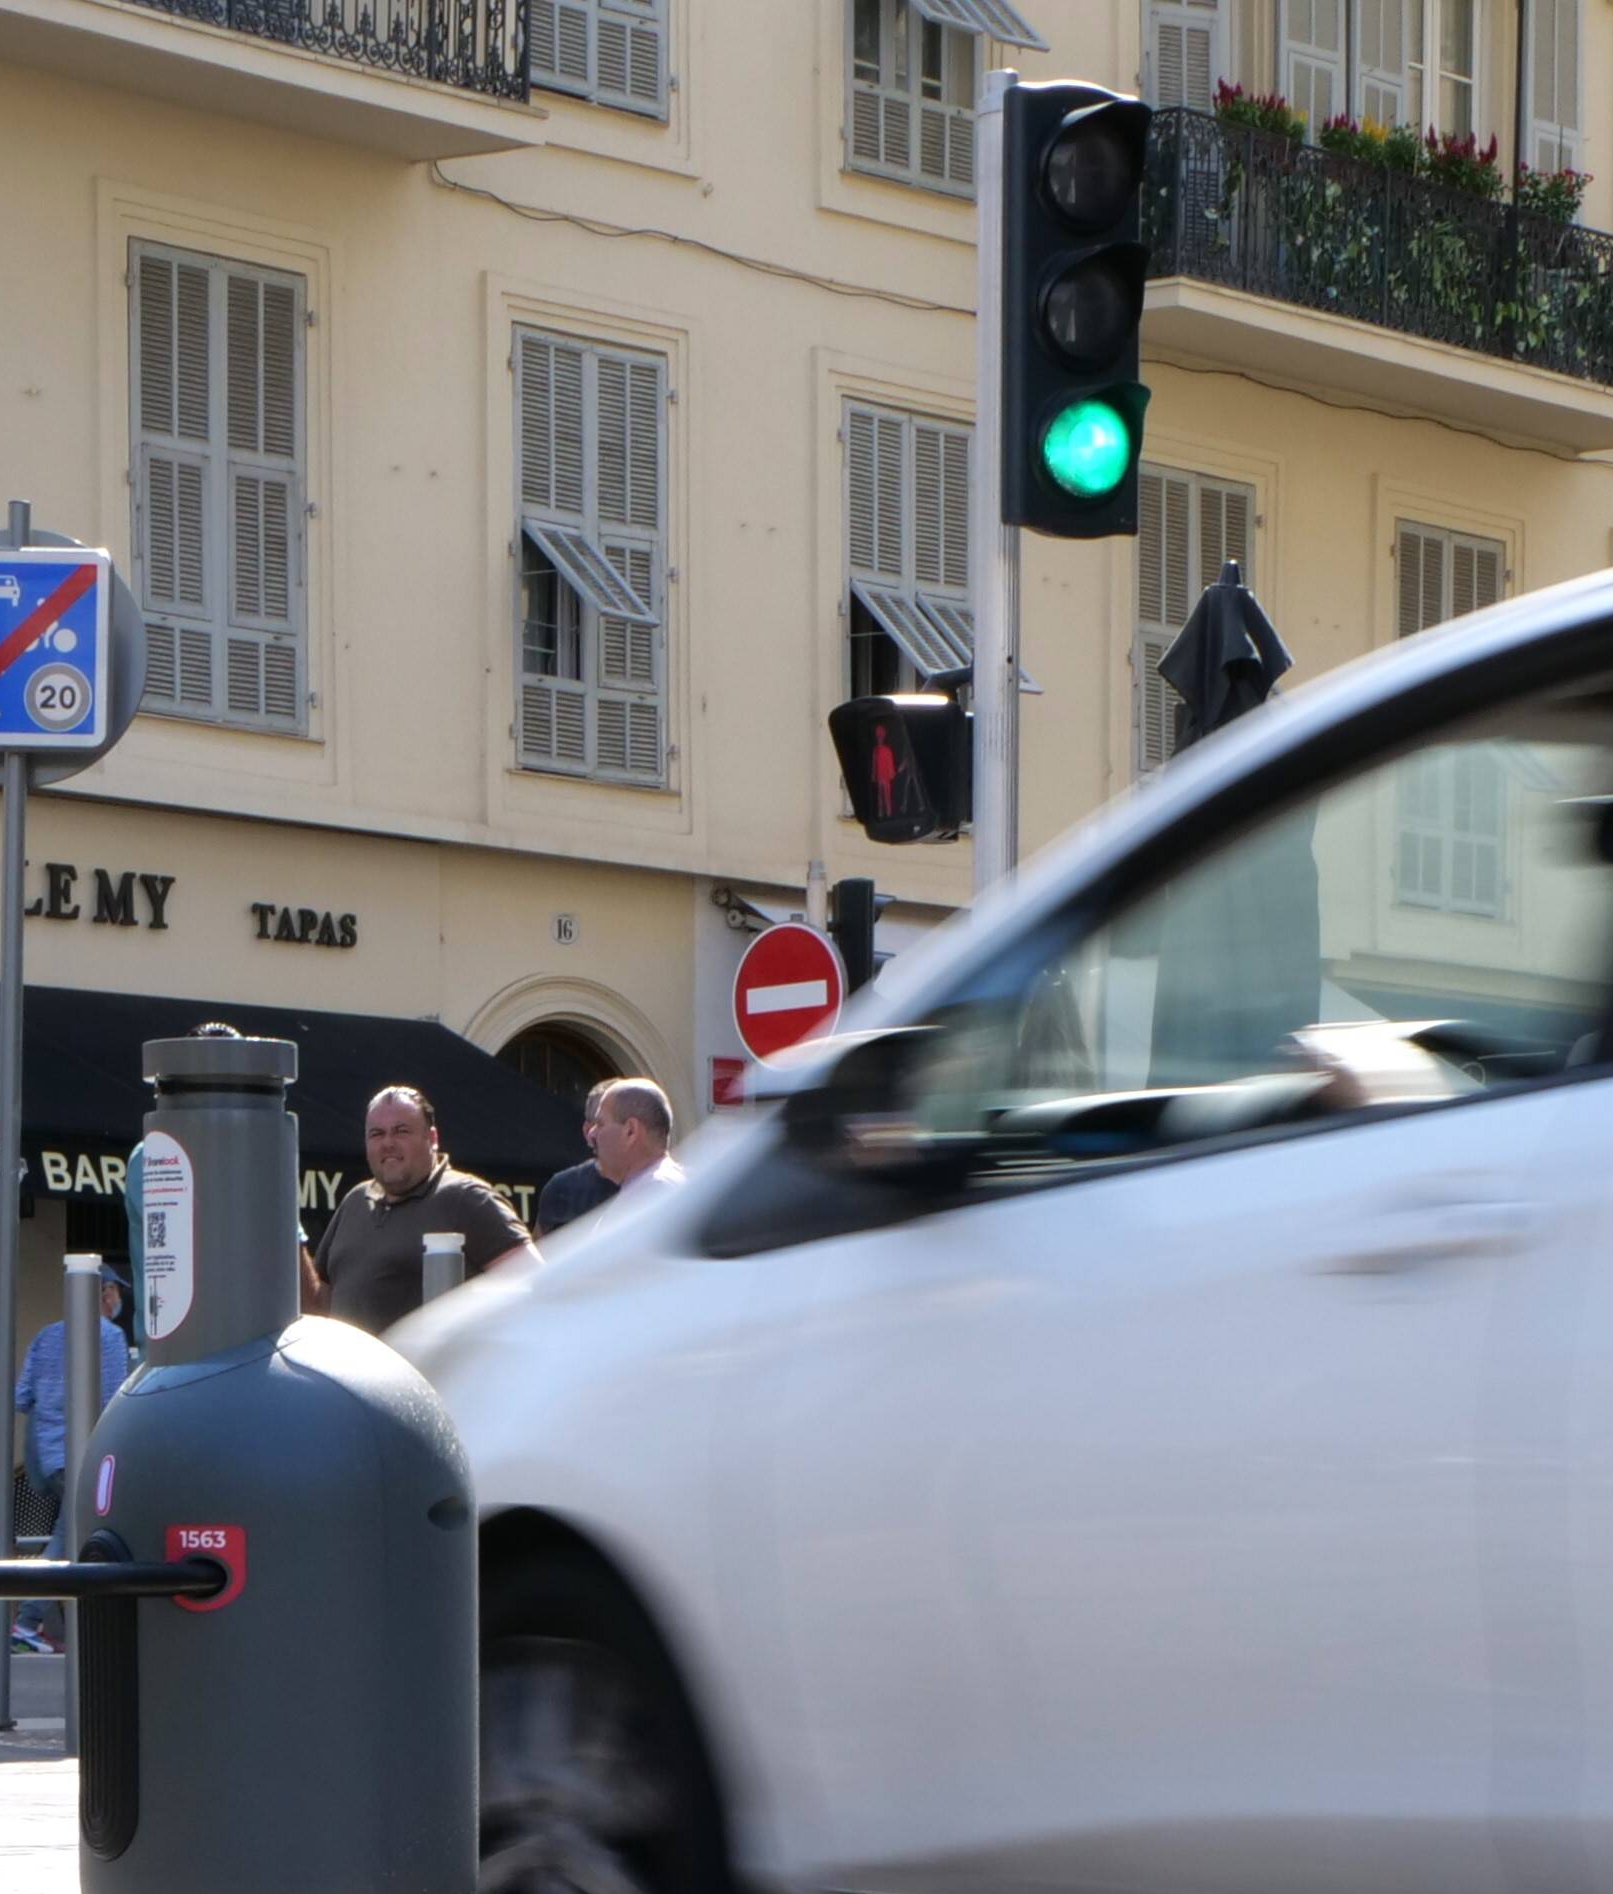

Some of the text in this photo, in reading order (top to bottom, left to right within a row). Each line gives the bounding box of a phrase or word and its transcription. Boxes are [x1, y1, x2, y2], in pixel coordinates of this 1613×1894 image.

[39, 684, 77, 710] 20
[92, 868, 176, 930] MY
[250, 901, 358, 949] TAPAS
[556, 918, 573, 941] 16
[41, 1151, 127, 1195] BAR
[179, 1530, 227, 1549] 1563
